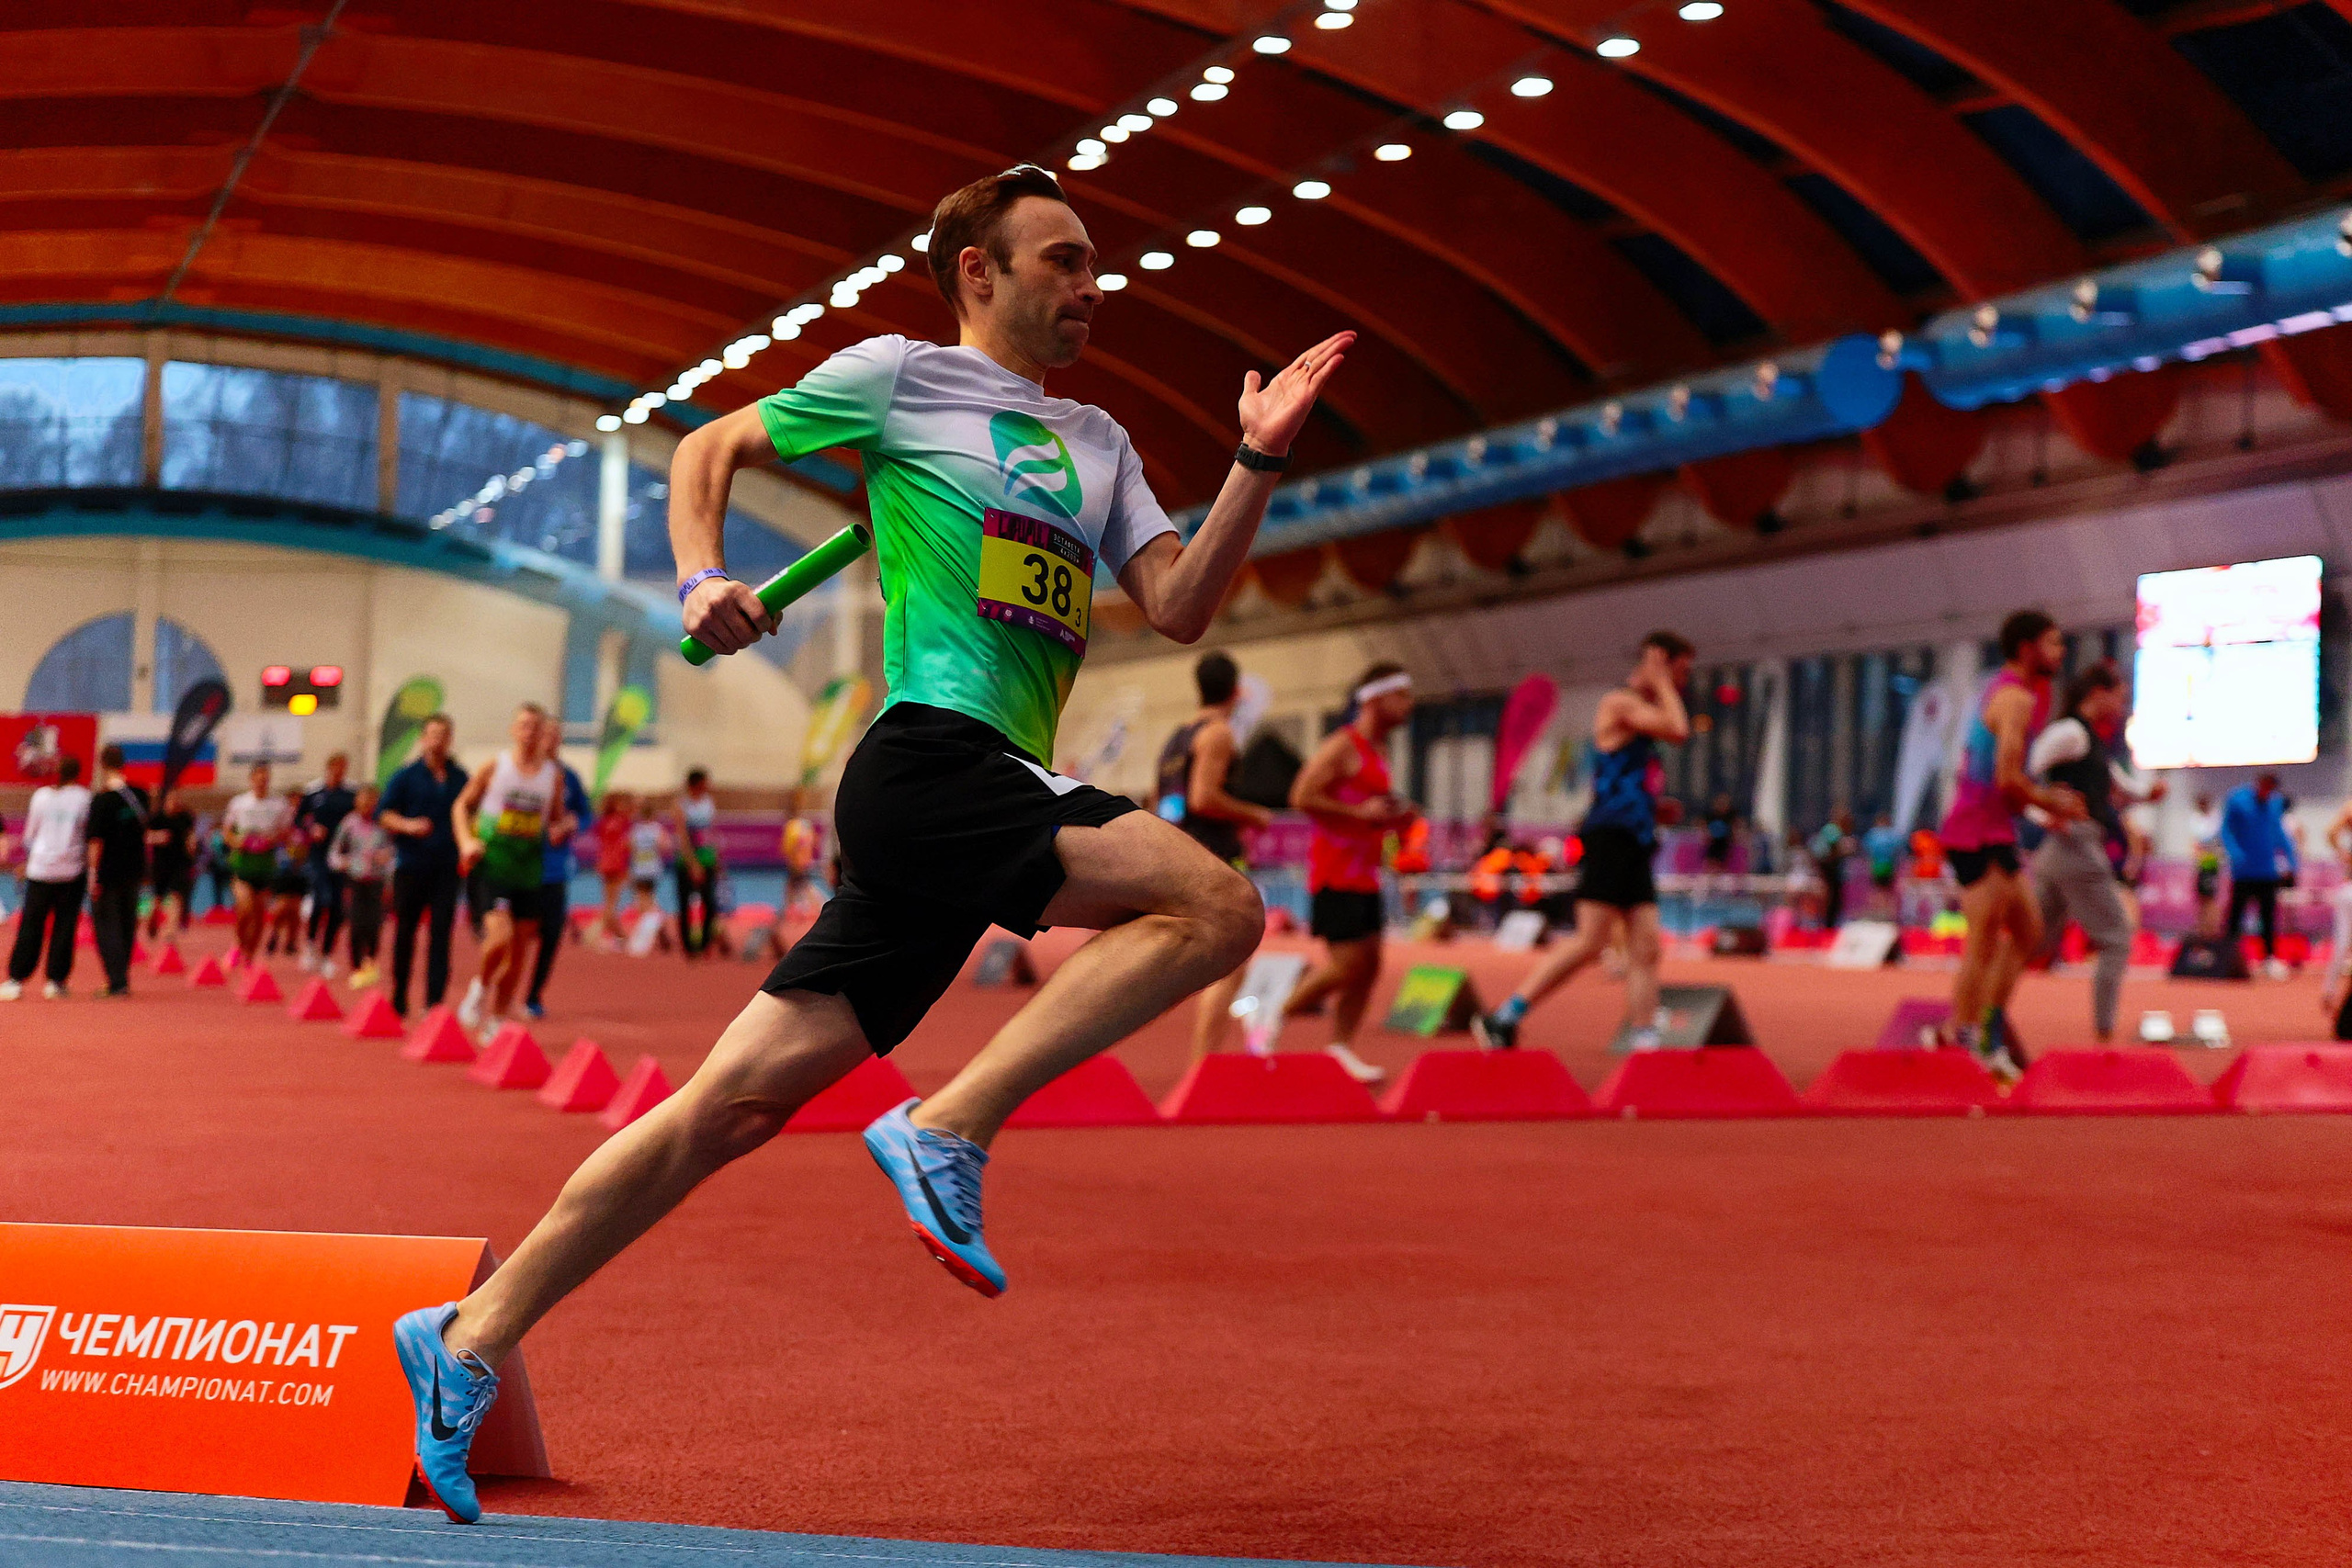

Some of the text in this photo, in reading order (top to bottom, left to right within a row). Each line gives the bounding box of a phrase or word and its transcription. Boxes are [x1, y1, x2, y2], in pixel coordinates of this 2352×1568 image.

[1021, 553, 1072, 617] 38
[1075, 607, 1082, 627] 3
[59, 1312, 358, 1369] ЧЕМПИОНАТ
[40, 1369, 334, 1407] WWW.CHAMPIONAT.COM
